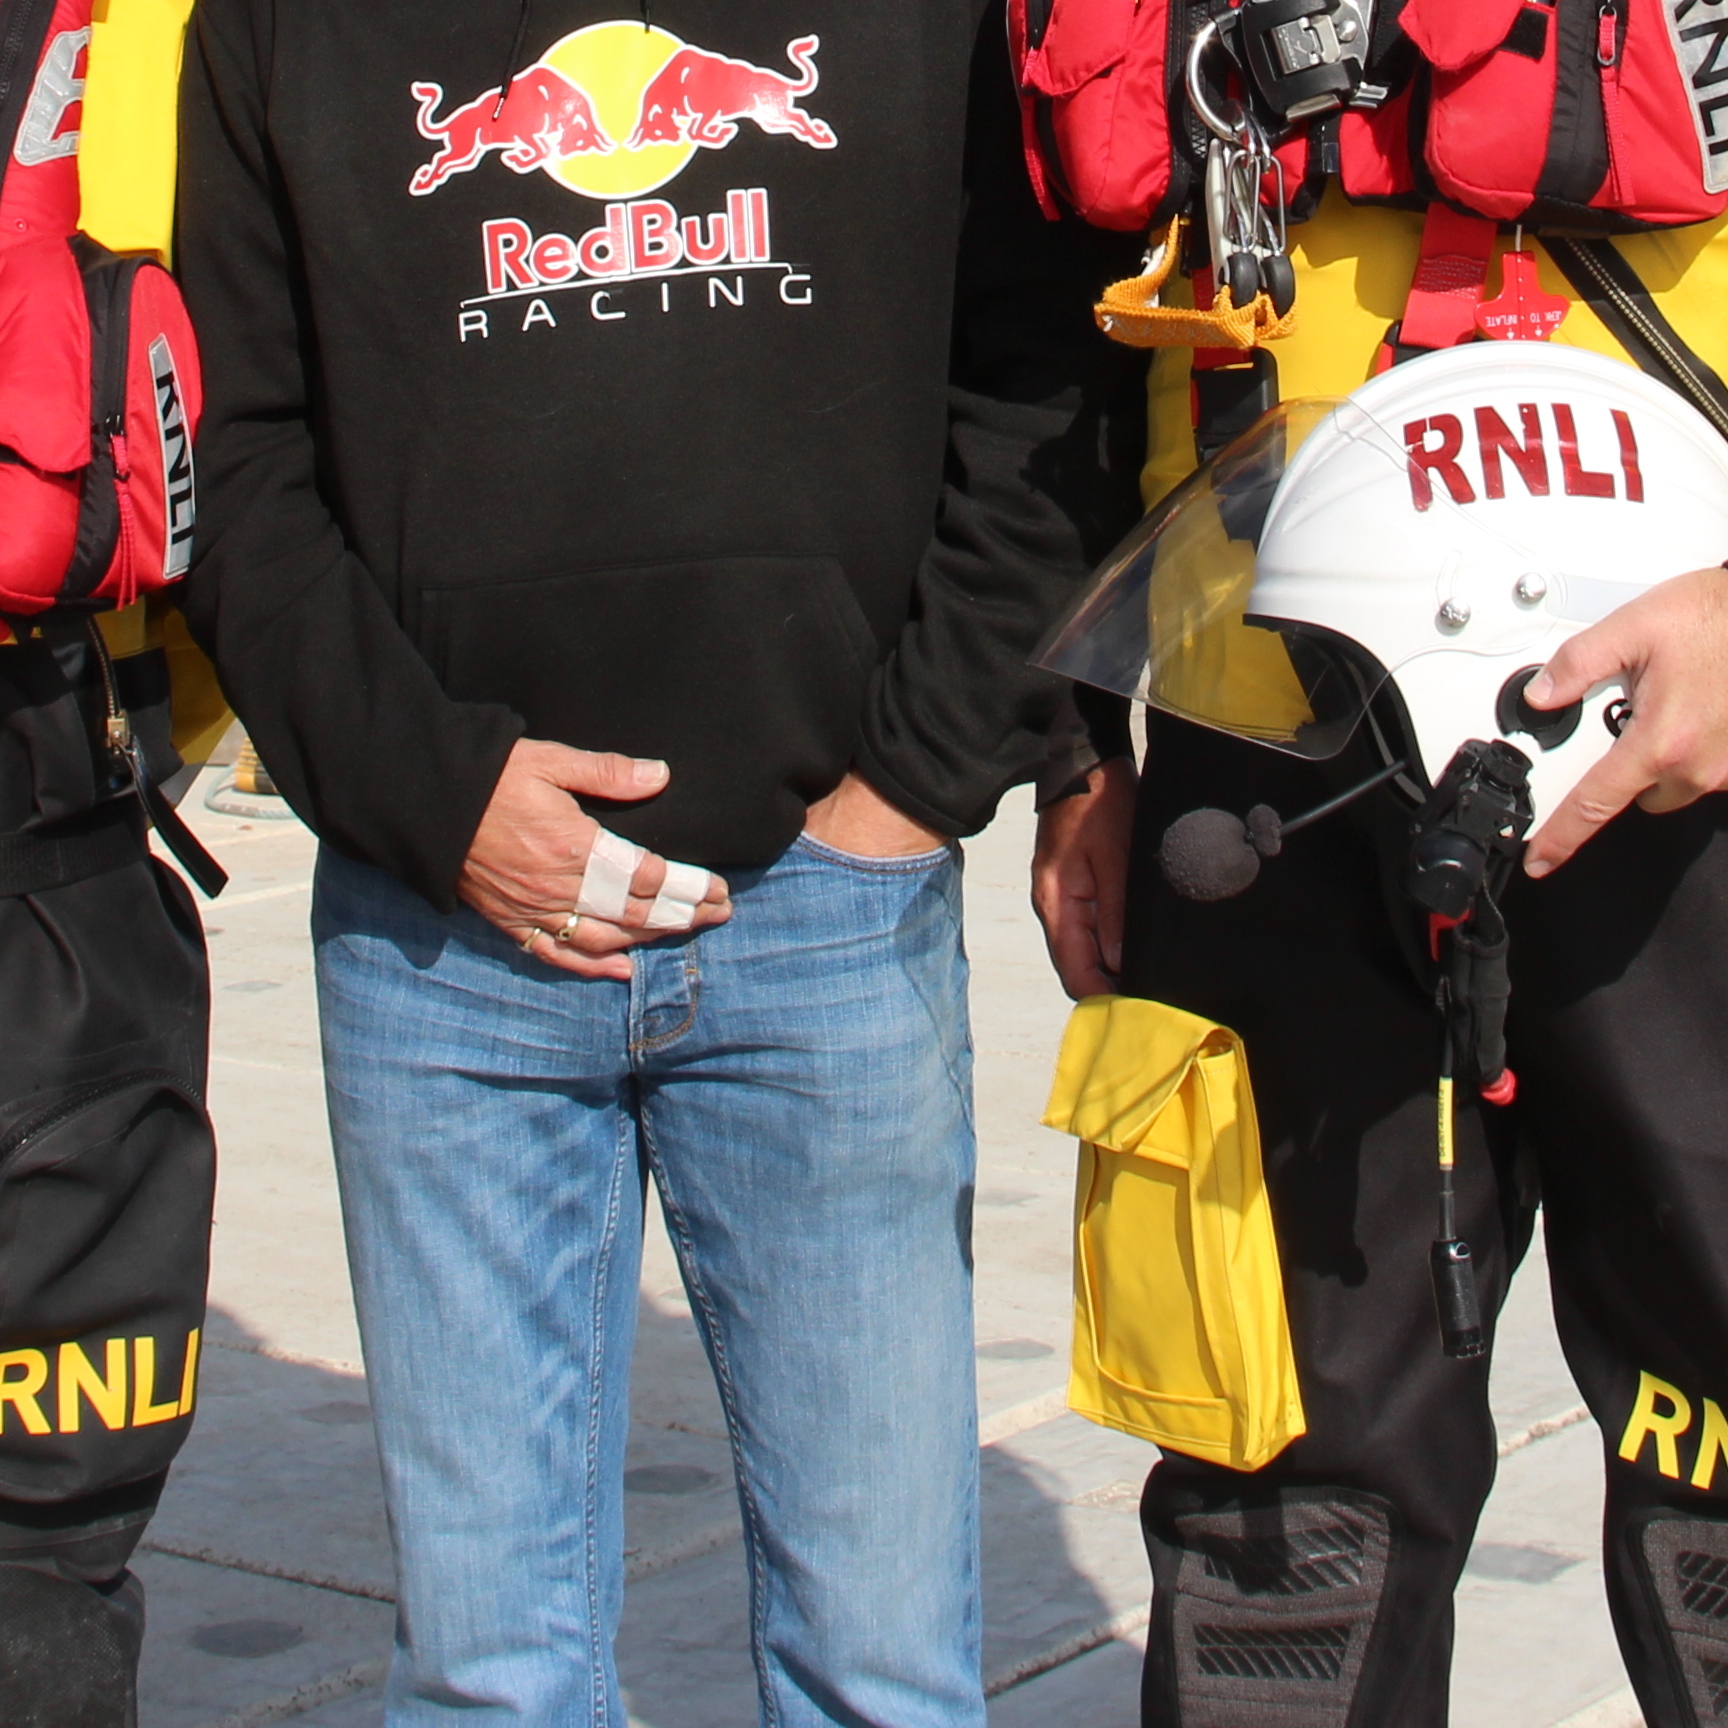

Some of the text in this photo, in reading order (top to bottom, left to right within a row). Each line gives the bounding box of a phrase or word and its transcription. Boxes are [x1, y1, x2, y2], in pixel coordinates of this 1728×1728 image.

[458, 274, 814, 343] RACING
[1485, 310, 1563, 328] JERK TO INFLATE
[1402, 402, 1646, 513] RNLI
